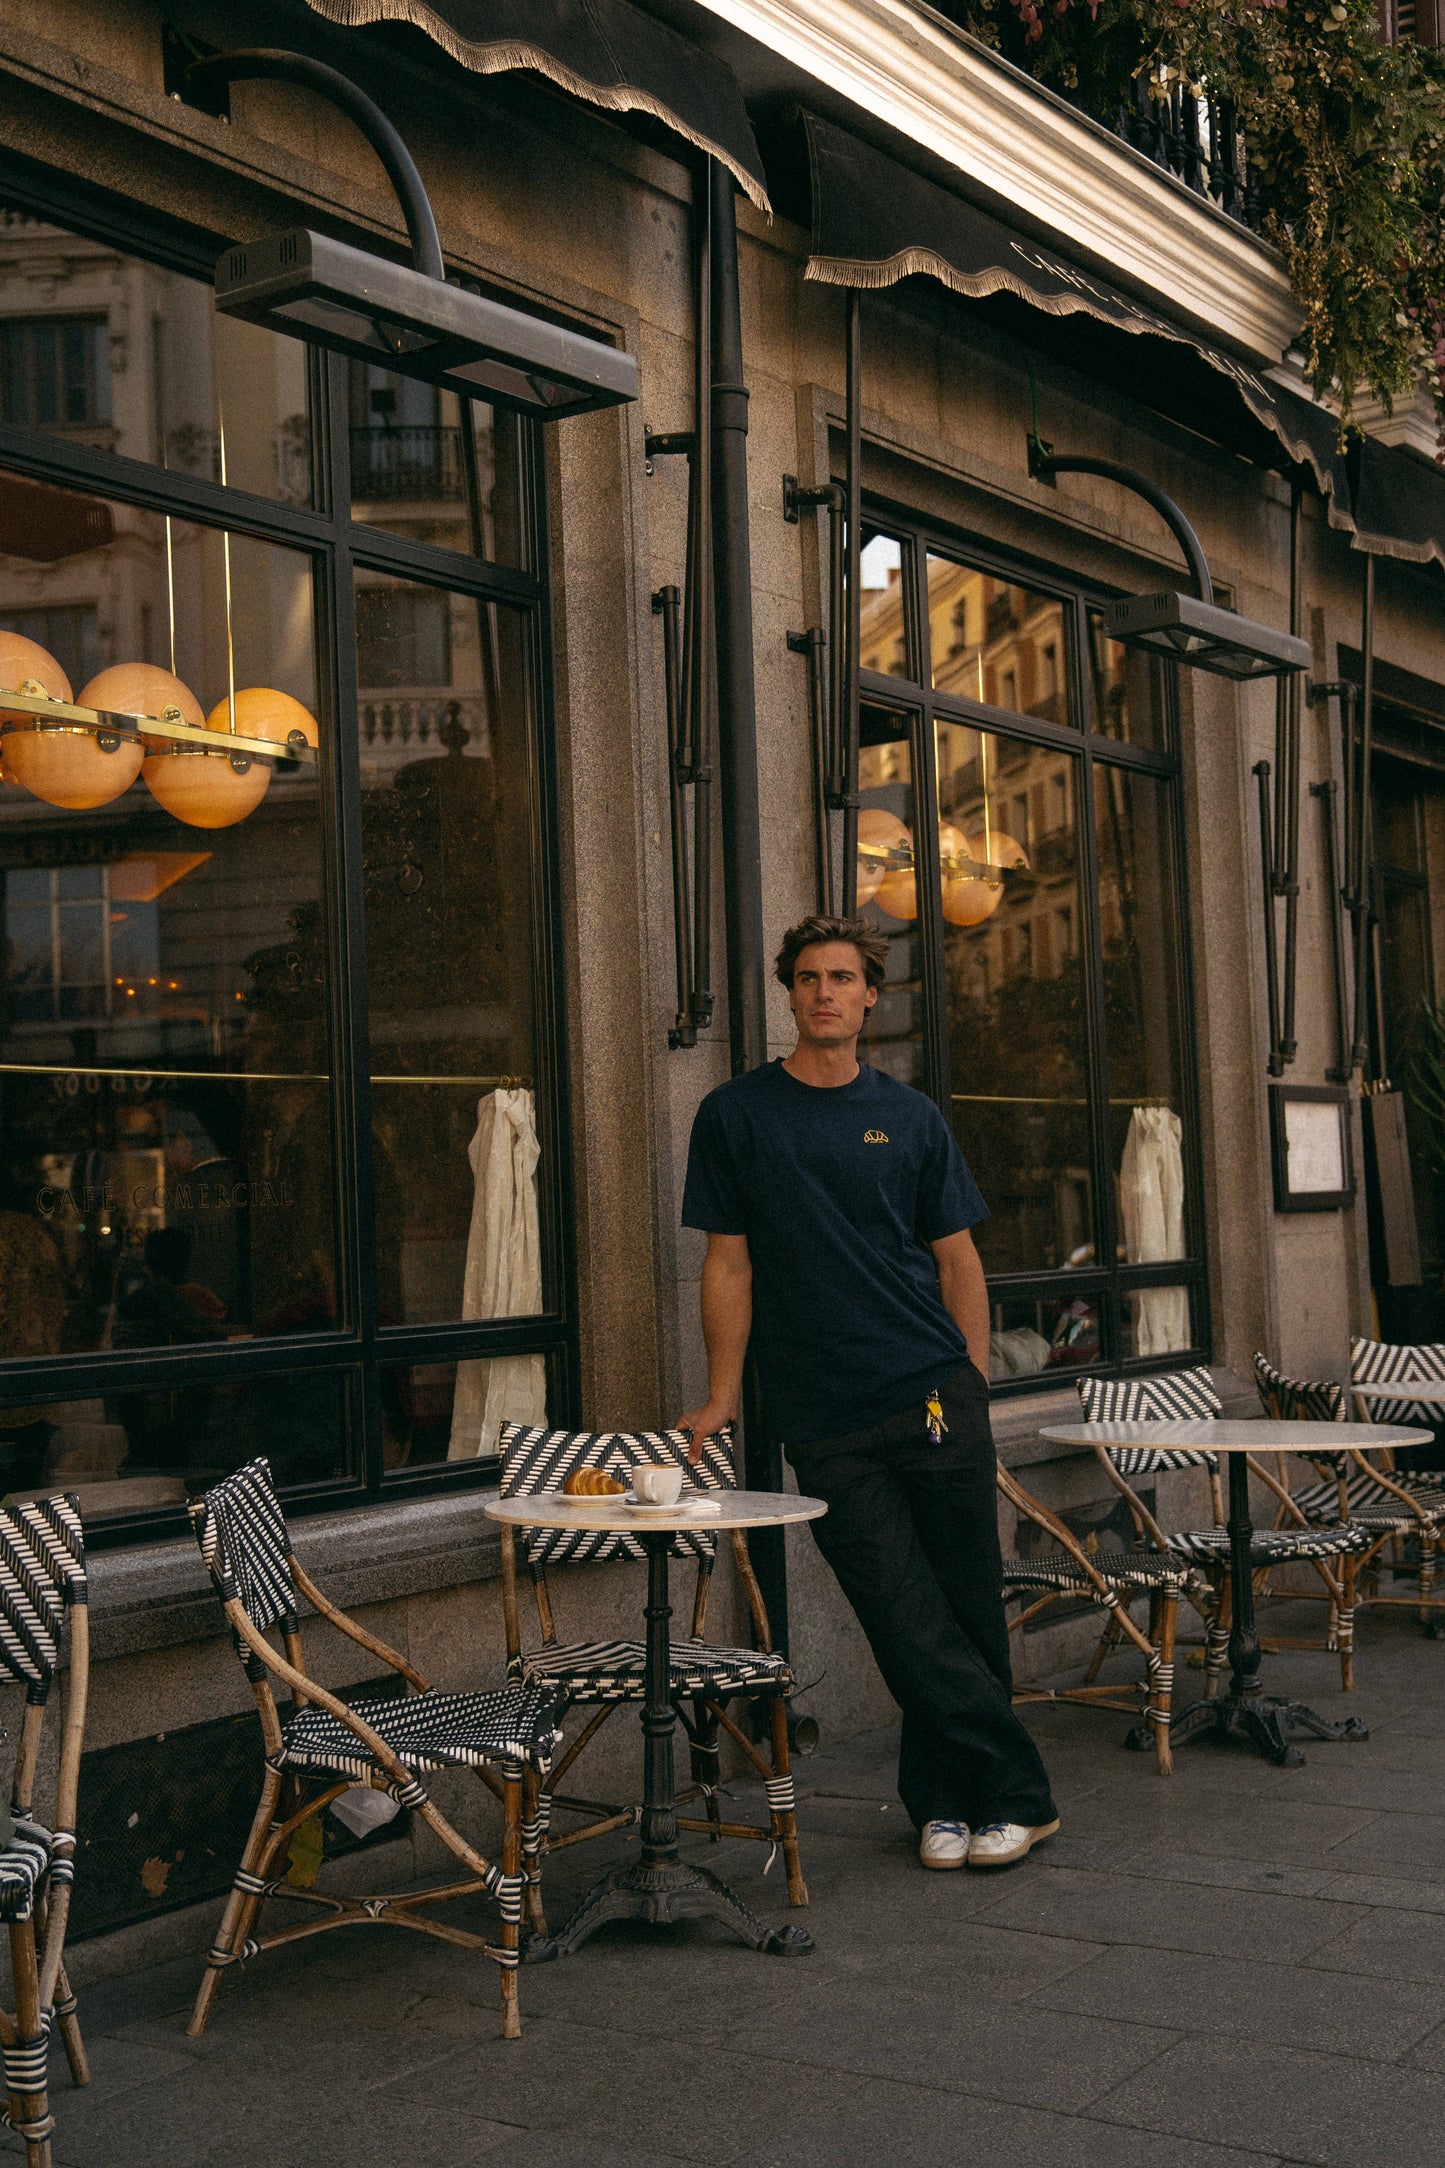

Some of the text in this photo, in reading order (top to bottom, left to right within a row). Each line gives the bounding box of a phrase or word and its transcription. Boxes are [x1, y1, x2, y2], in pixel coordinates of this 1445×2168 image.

[1010, 241, 1110, 302] CAFÉ
[35, 1178, 294, 1215] CAFÉ COMERCIAL
